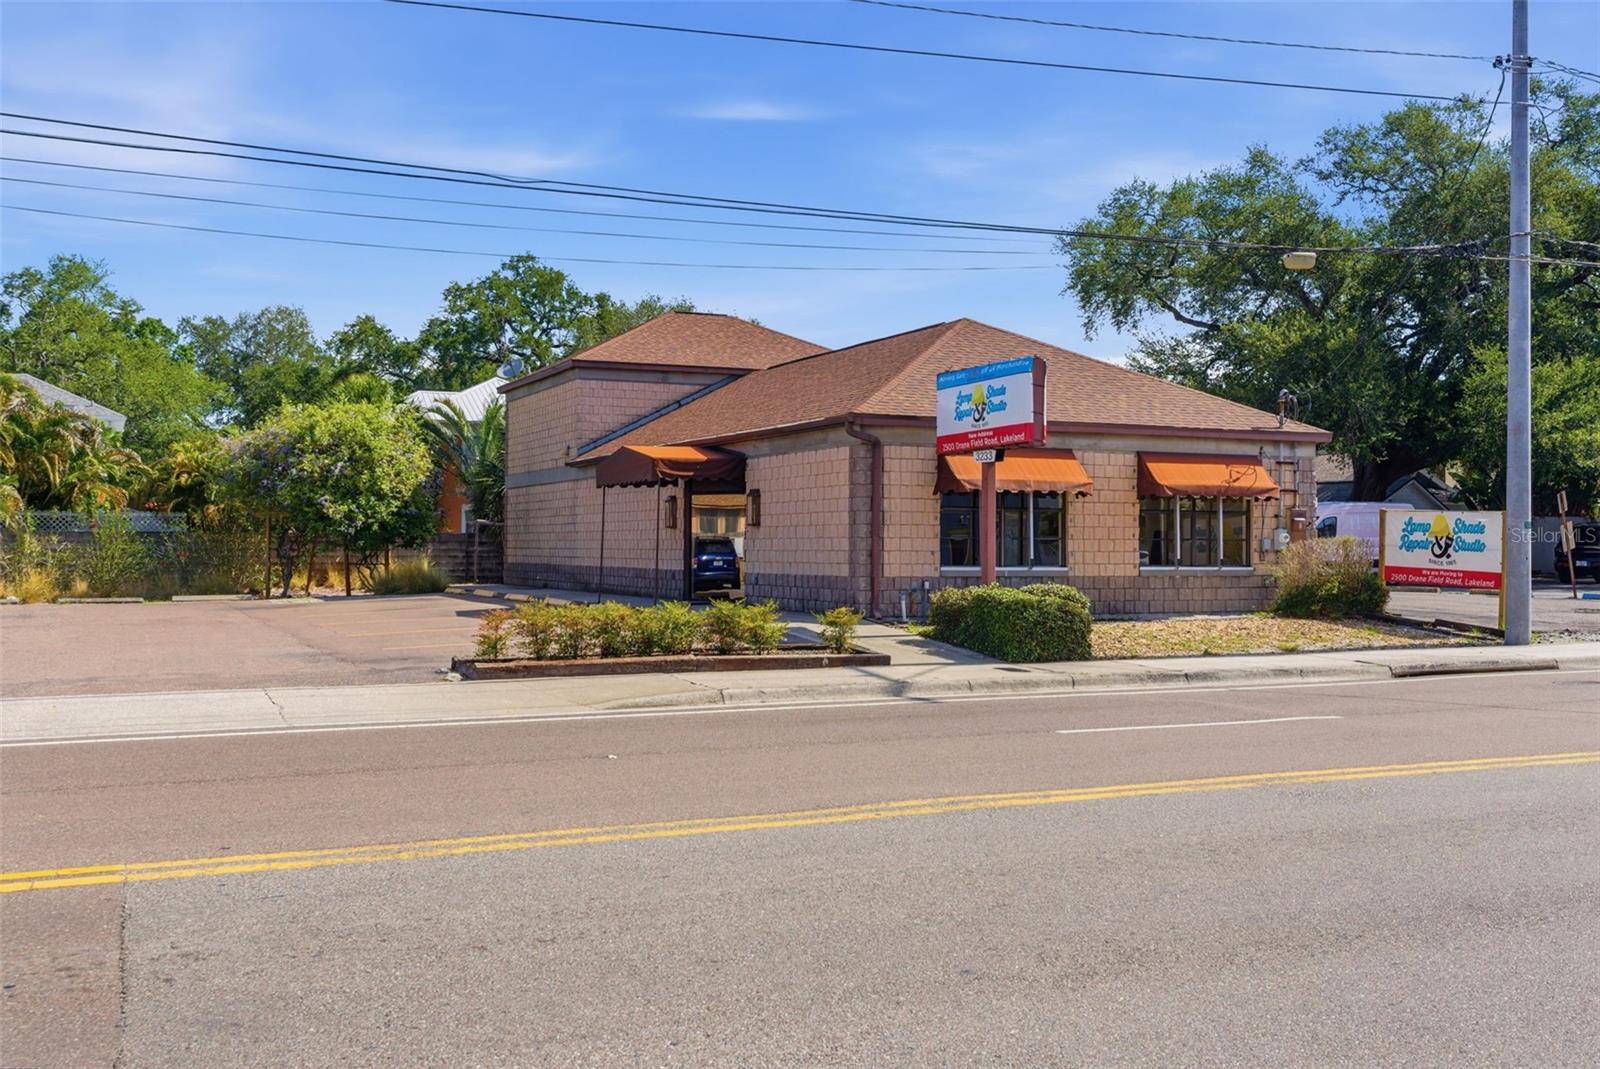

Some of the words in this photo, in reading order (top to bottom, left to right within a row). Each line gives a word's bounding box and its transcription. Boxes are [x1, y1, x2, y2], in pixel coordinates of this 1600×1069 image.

[956, 390, 972, 407] Lamp
[986, 384, 1006, 400] Shade
[954, 405, 975, 422] Repair
[986, 400, 1008, 415] Studio
[942, 443, 955, 452] 2500
[970, 439, 984, 448] Field
[1000, 432, 1025, 444] Lakeland
[975, 451, 993, 461] 3233
[1402, 517, 1432, 536] Lamp
[1453, 518, 1486, 535] Shade
[1398, 534, 1434, 553] Repair
[1453, 536, 1487, 553] Studio
[1391, 573, 1407, 581] 2500
[1408, 574, 1427, 583] Drane
[1427, 575, 1444, 584] Field
[1464, 578, 1495, 588] Lakeland
